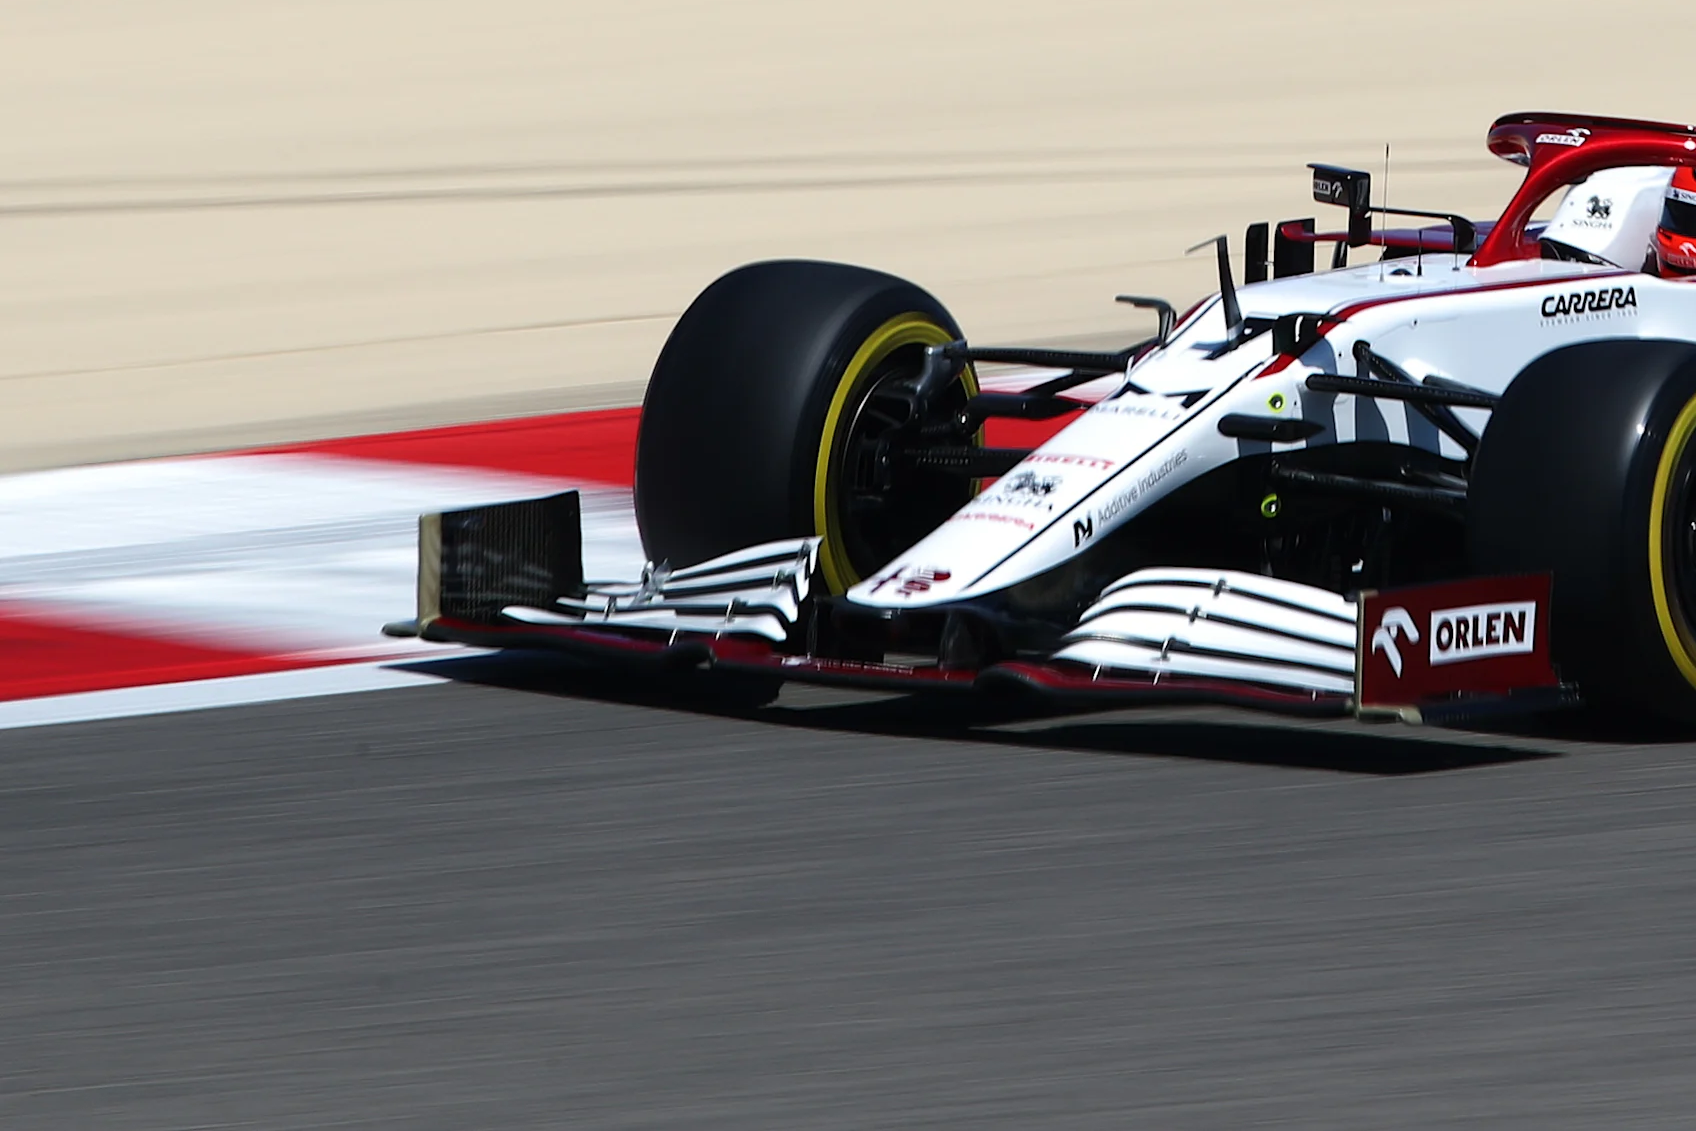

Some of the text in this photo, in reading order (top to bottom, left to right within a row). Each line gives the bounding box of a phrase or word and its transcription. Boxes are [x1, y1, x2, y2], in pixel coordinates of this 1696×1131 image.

[1541, 286, 1637, 318] CARRERA
[1097, 486, 1138, 526] Additive
[1138, 448, 1188, 495] Industries
[1436, 610, 1526, 652] ORLEN
